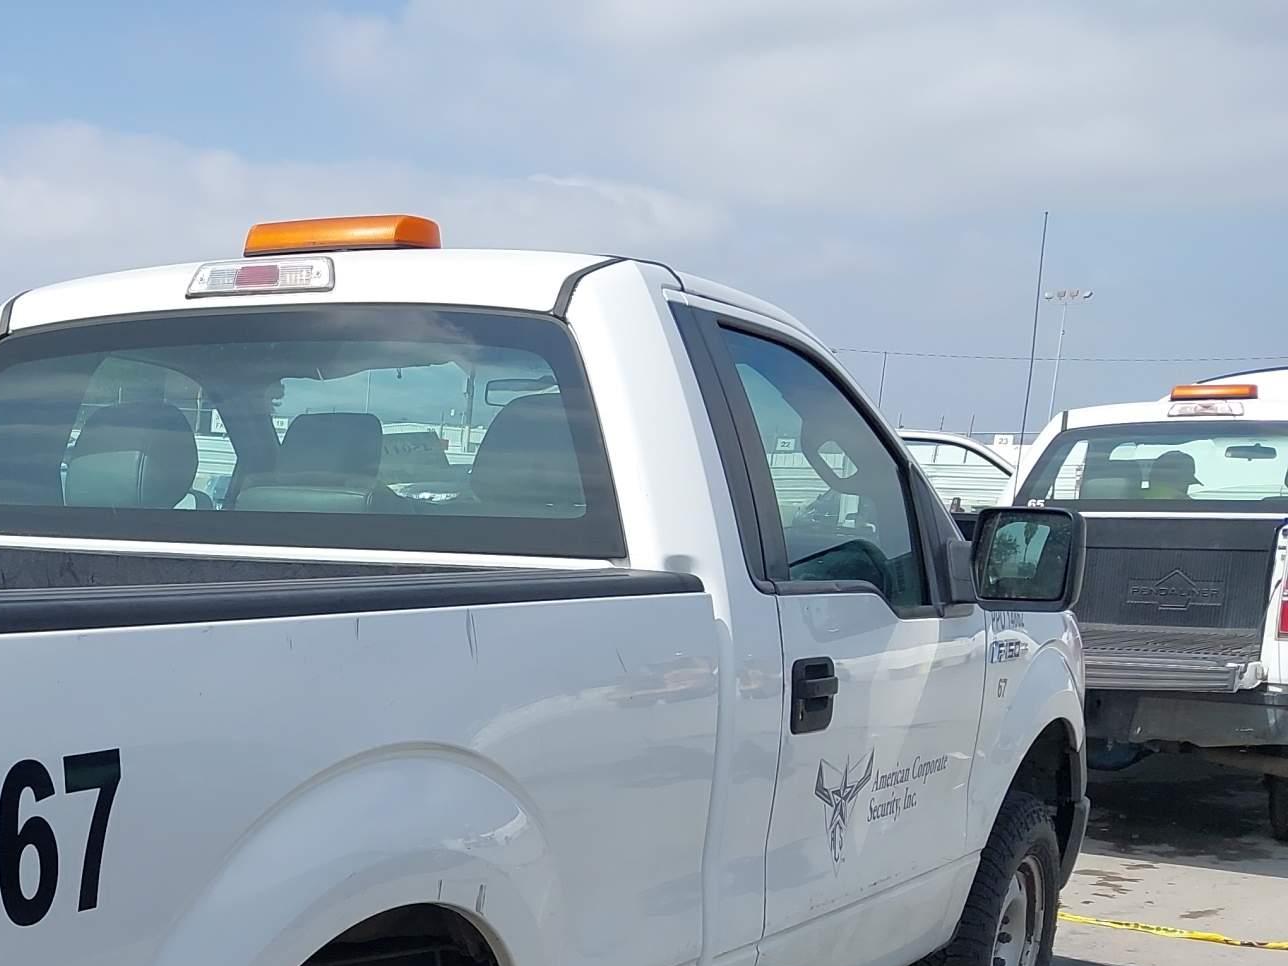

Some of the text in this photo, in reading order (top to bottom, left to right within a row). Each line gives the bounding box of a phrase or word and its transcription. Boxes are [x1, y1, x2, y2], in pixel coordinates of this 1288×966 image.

[998, 678, 1008, 697] 67
[871, 755, 949, 792] American Corporate
[867, 786, 917, 822] Security, Inc.
